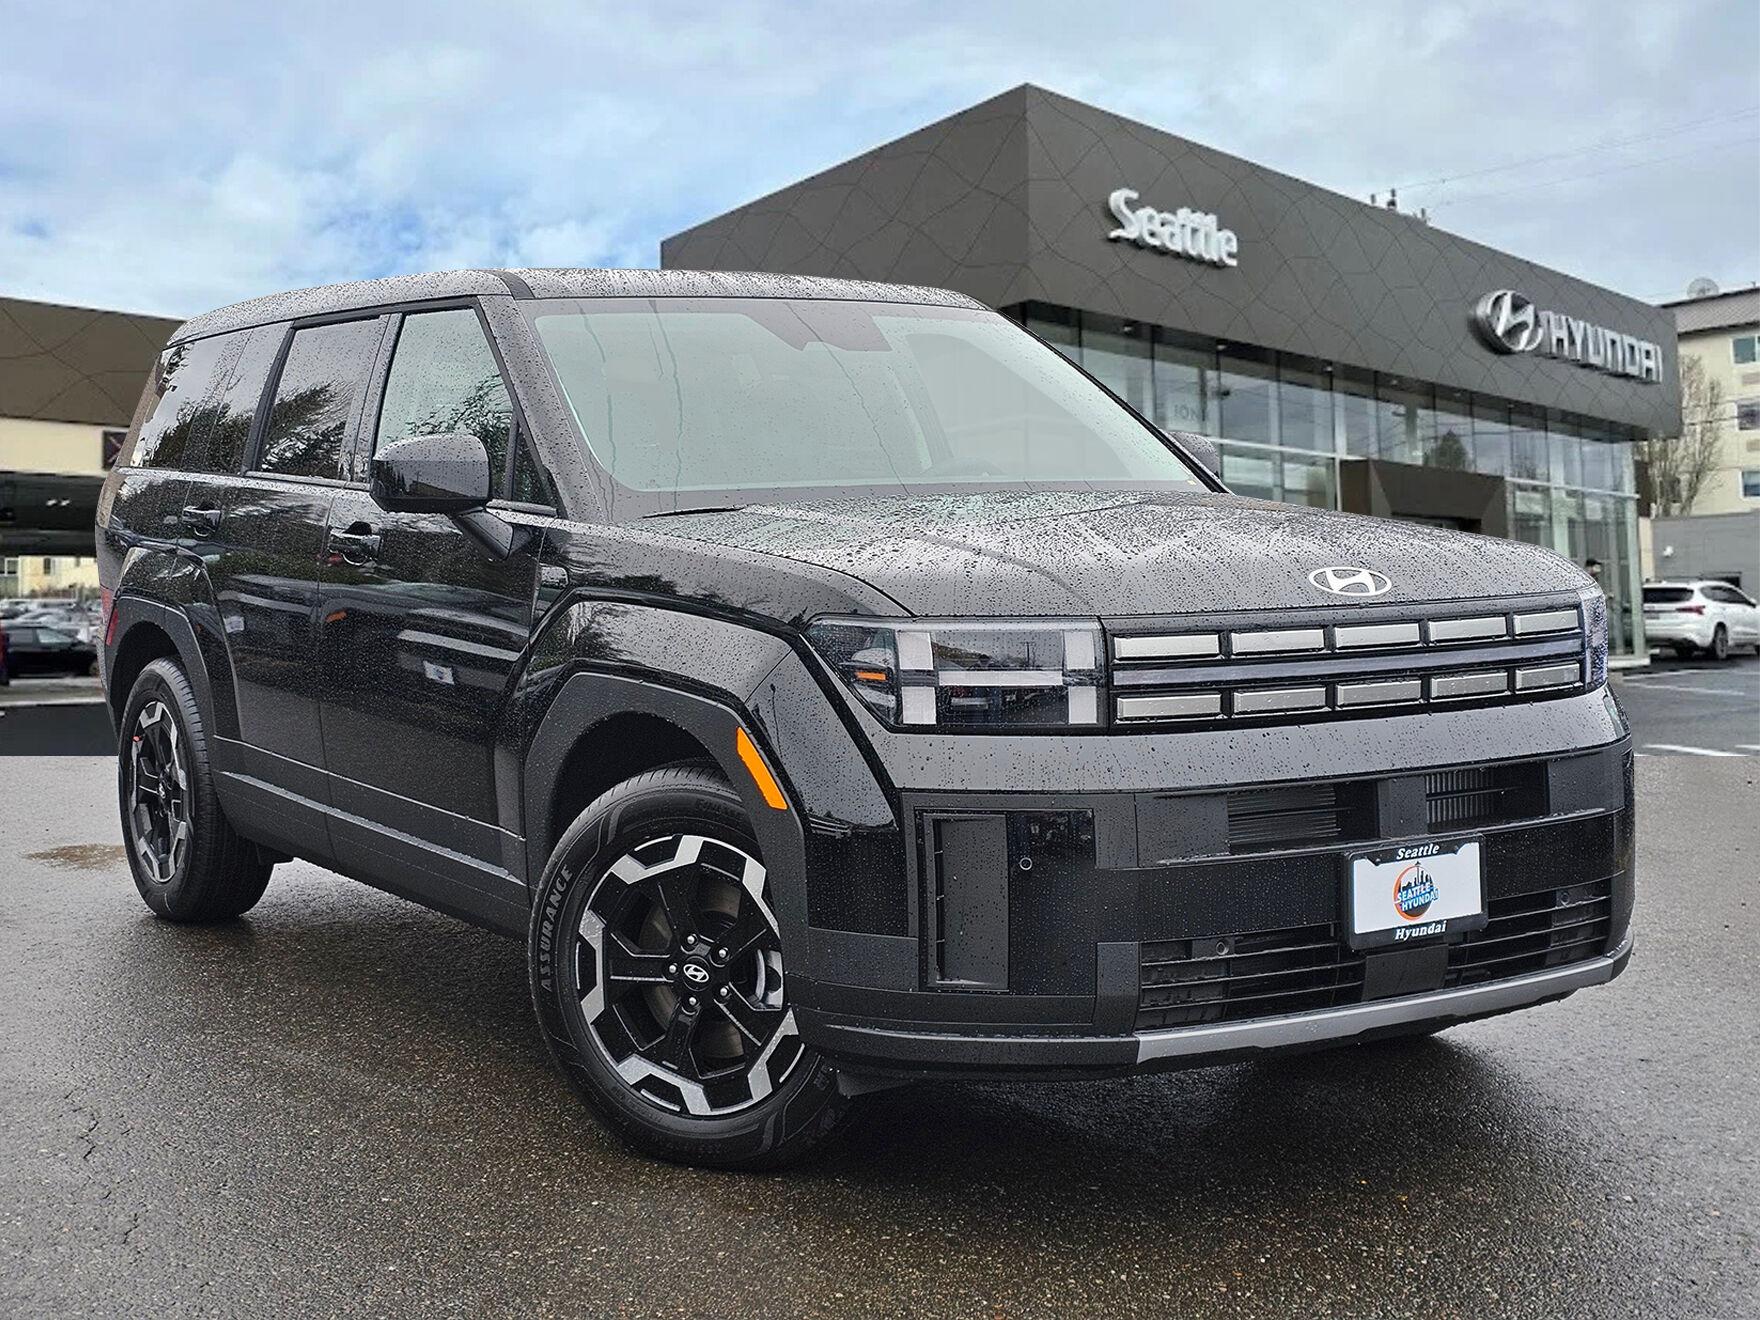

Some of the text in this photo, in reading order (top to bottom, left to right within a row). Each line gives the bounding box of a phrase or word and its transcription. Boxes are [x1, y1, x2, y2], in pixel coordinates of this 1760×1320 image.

[1109, 188, 1237, 266] Seattle
[1540, 310, 1663, 383] HYUNDAI
[1396, 843, 1440, 860] Seattle
[1397, 882, 1432, 902] SEATTLE
[1402, 887, 1439, 911] HYUNDAI
[540, 864, 573, 992] ASSURANCE
[1395, 920, 1447, 941] Hyundai
